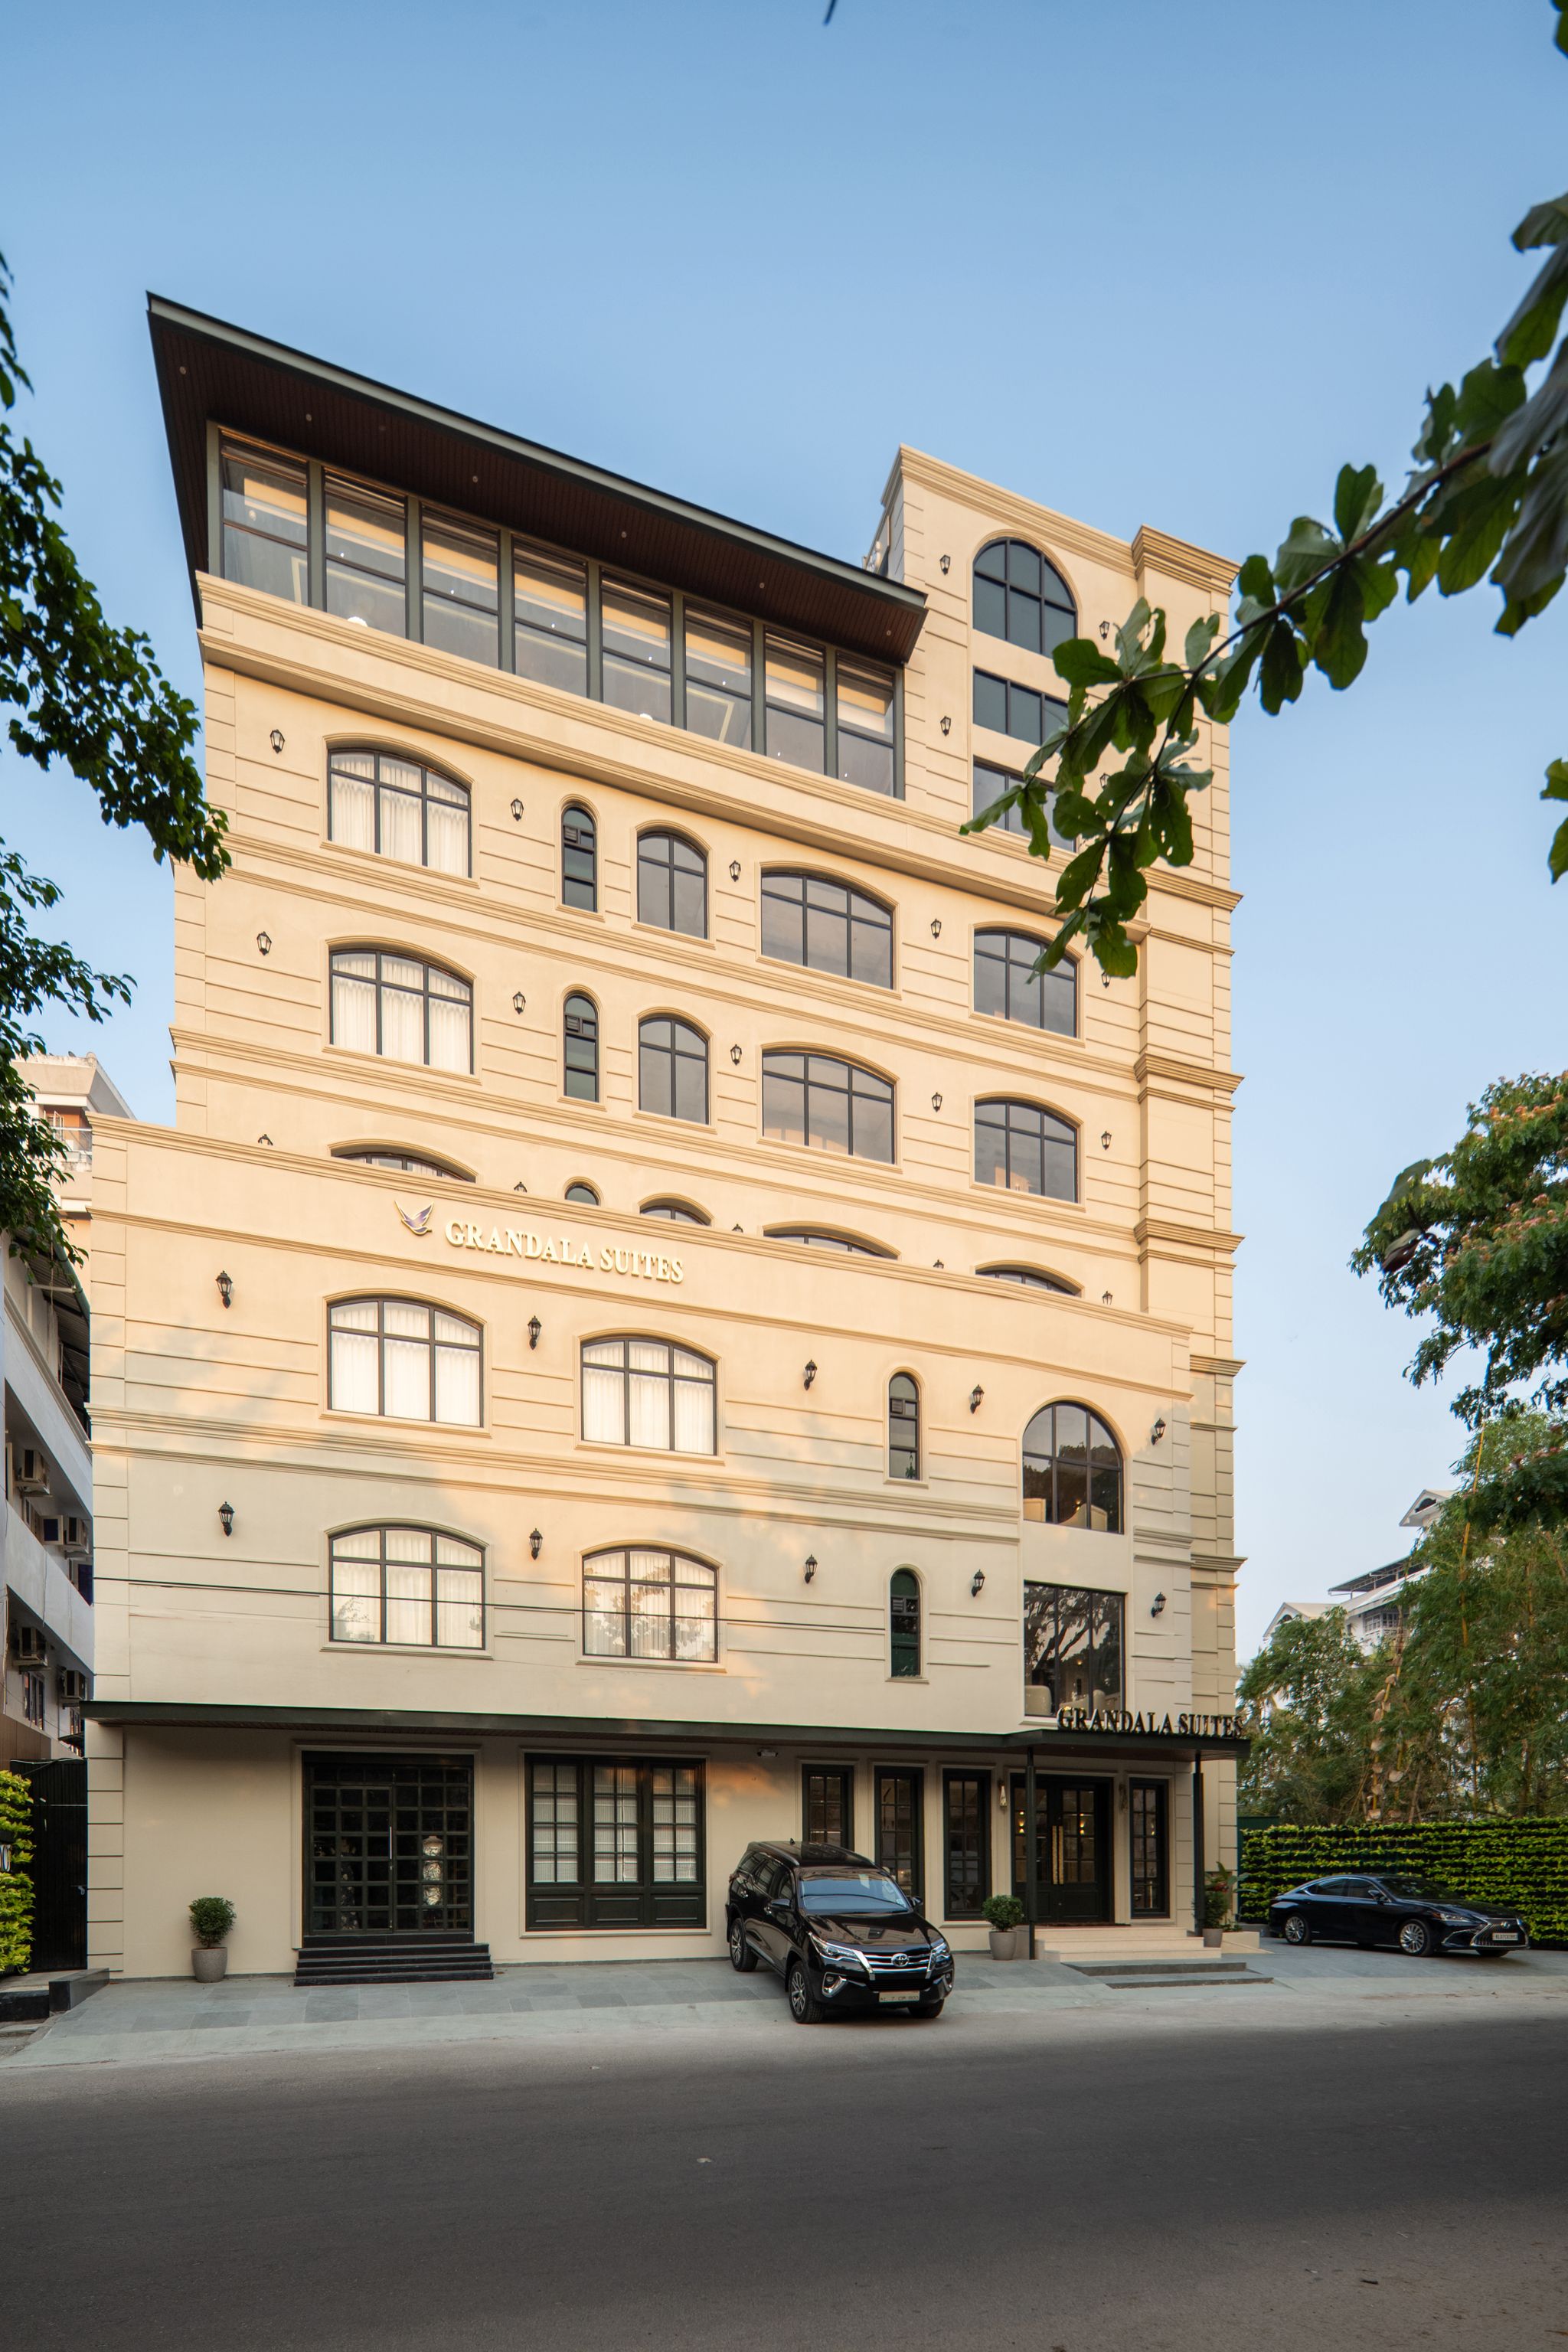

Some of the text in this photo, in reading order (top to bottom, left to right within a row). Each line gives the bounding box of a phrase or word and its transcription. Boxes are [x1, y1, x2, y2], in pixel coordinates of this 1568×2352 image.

[445, 1220, 684, 1283] GRANDALA SUITES
[1057, 1707, 1244, 1739] GRANDALA SUITES
